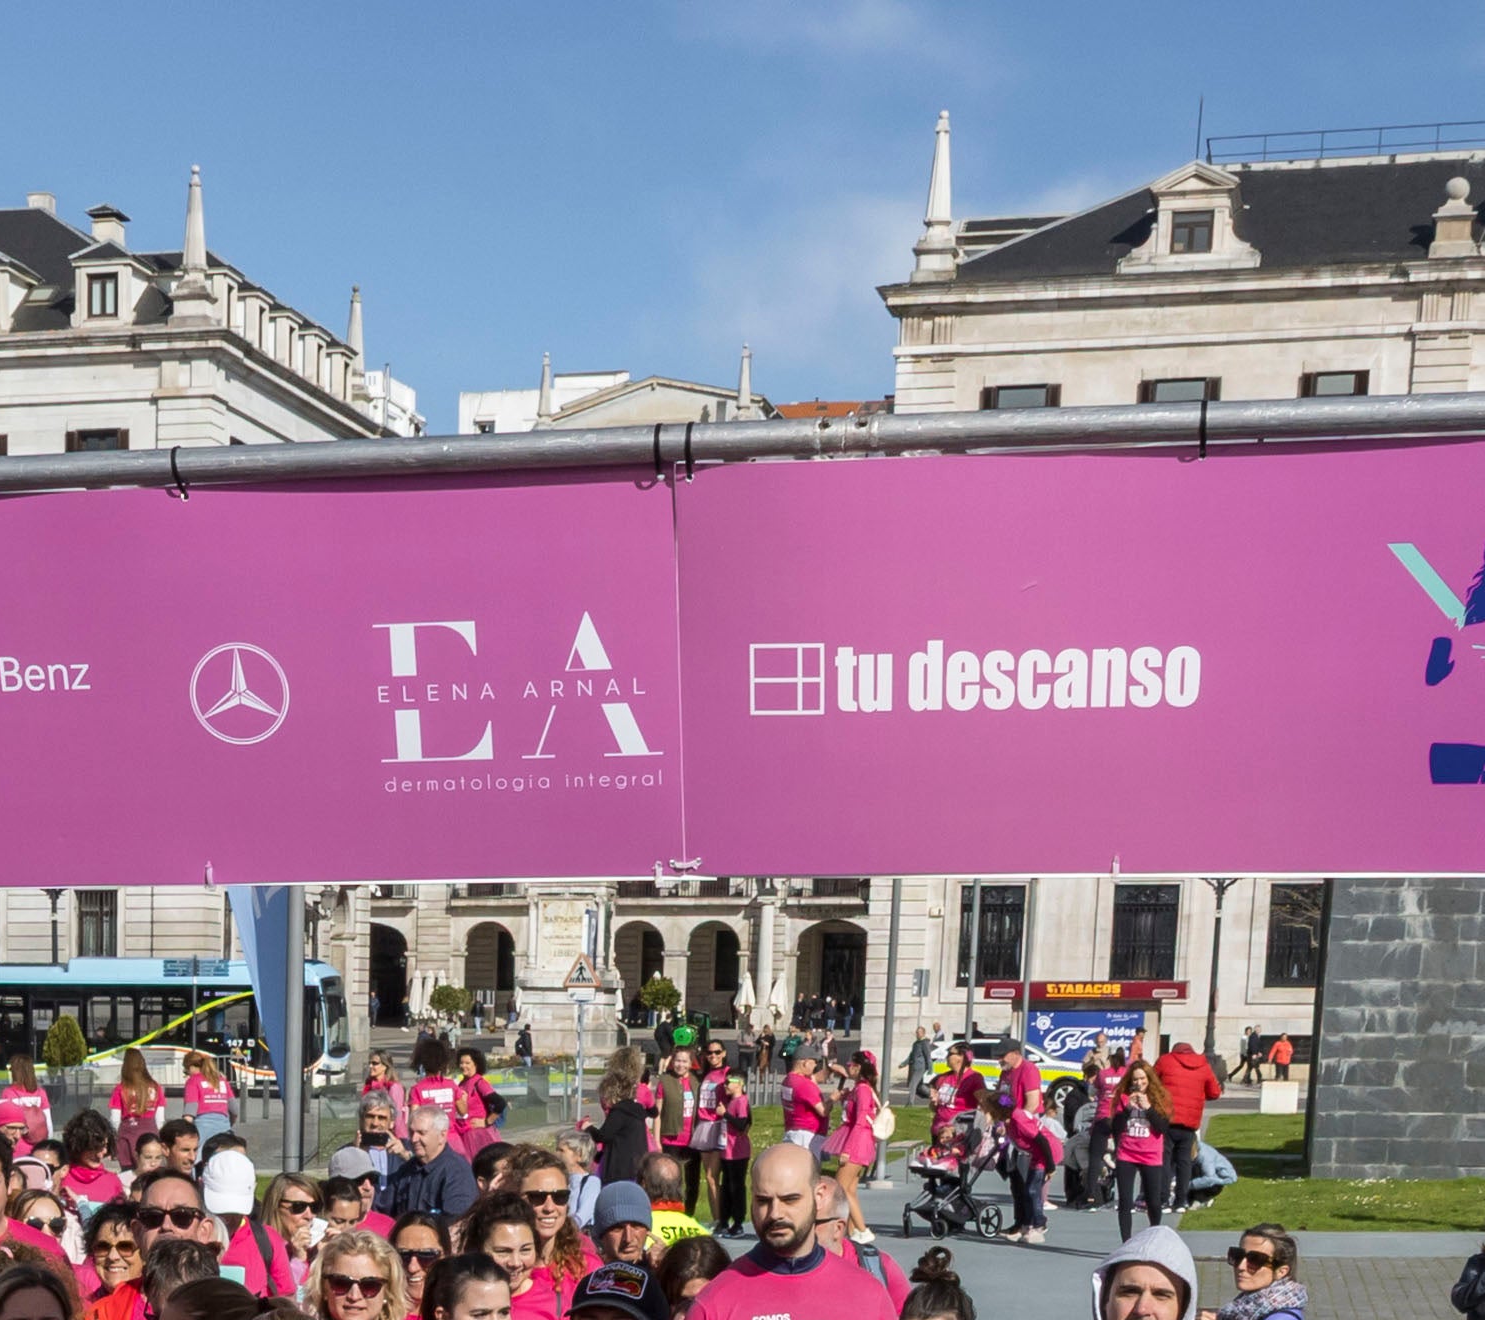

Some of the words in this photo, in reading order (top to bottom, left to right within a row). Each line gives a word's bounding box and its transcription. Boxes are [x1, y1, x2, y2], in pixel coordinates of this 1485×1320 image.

[835, 646, 893, 713] tu
[908, 640, 1201, 711] descanso
[378, 682, 495, 703] ELENA
[523, 678, 646, 699] ARNAL
[565, 770, 664, 790] integral
[1058, 983, 1121, 994] TABACOS
